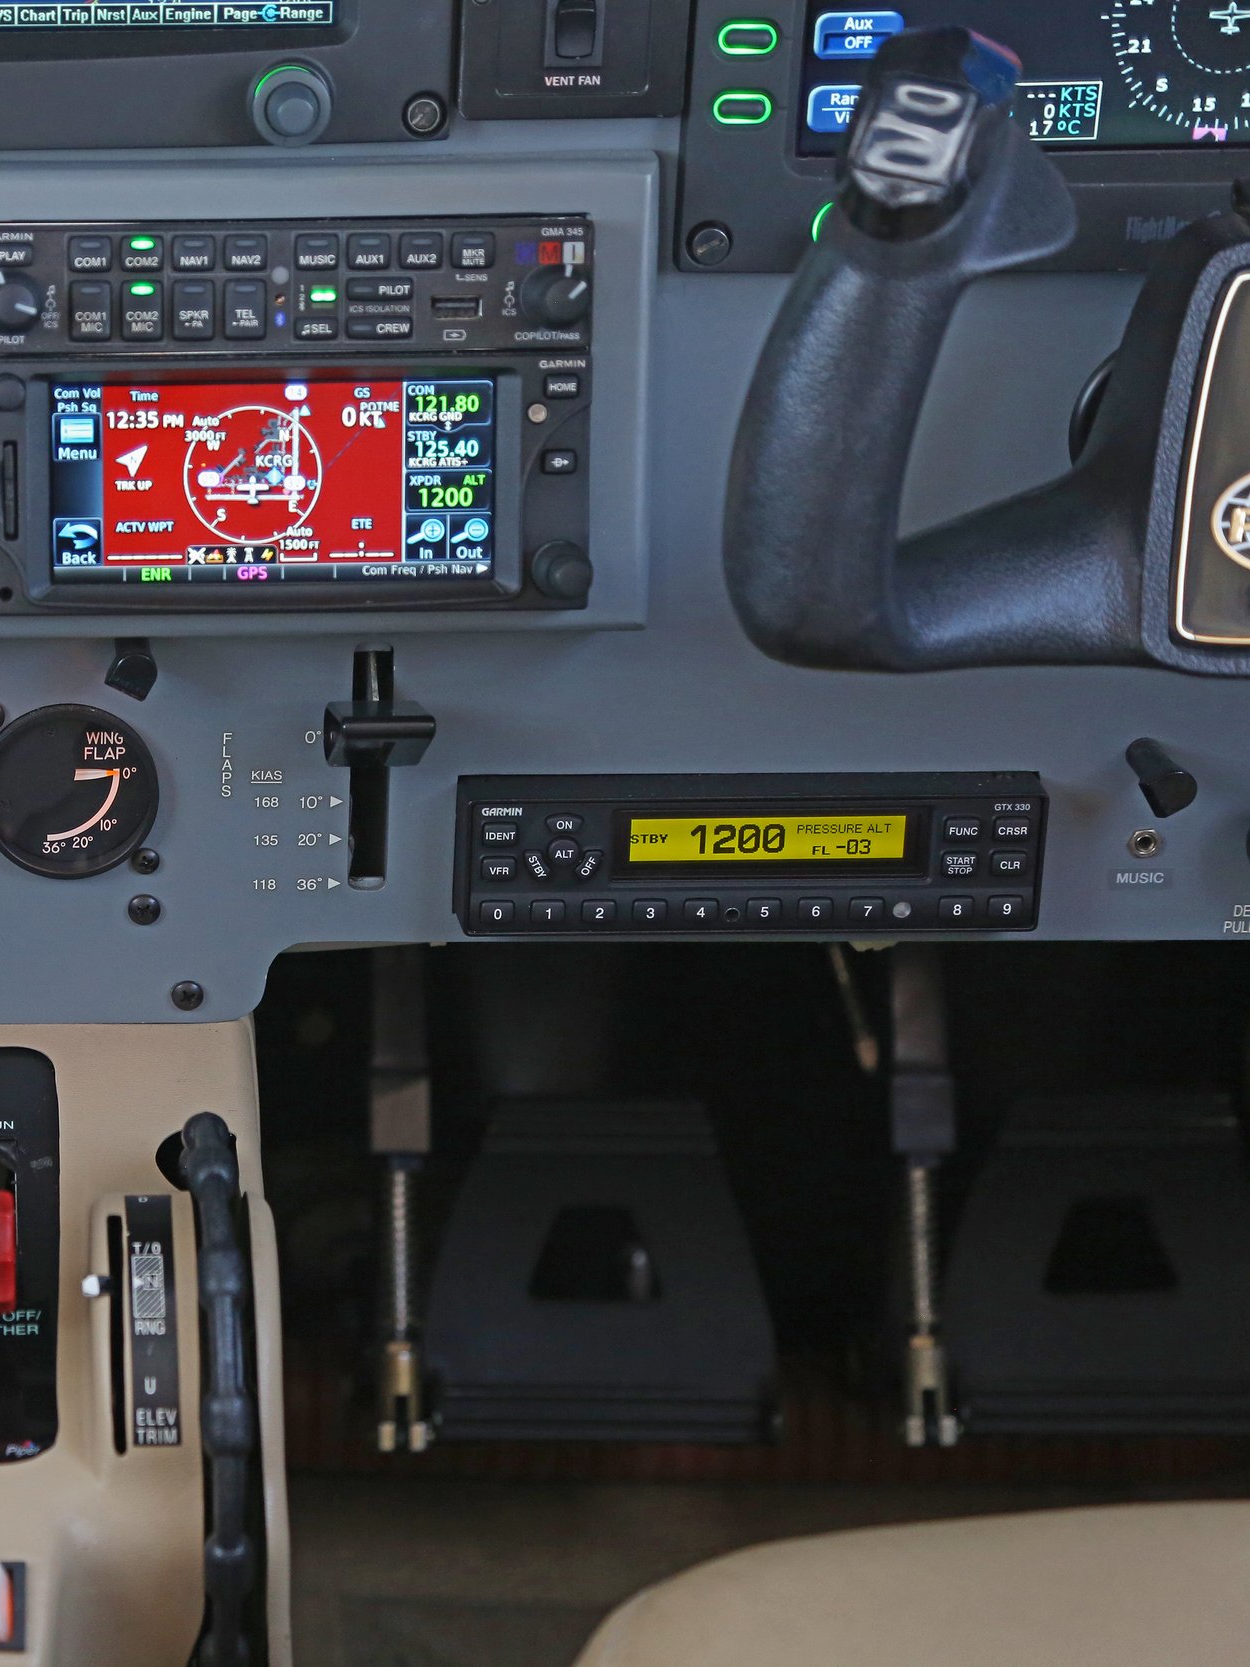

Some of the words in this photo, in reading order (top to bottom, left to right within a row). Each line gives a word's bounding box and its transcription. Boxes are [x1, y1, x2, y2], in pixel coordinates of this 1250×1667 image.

[20, 10, 56, 22] Chart
[63, 9, 89, 23] Trip
[97, 9, 125, 21] Nrst
[132, 9, 158, 20] Aux
[165, 8, 212, 21] Engine
[224, 8, 258, 22] Page
[280, 7, 323, 21] Range
[844, 17, 873, 31] Aux
[844, 36, 872, 49] OFF
[1128, 39, 1151, 53] 21
[545, 76, 575, 87] VENT
[578, 75, 601, 86] FAN
[1061, 86, 1097, 101] KTS
[1192, 97, 1216, 112] 15
[1044, 104, 1055, 119] 0
[1059, 104, 1096, 118] KTS
[541, 228, 564, 237] GMA
[566, 227, 584, 236] 345
[74, 257, 107, 268] COM1
[125, 256, 158, 267] COM2
[180, 256, 208, 266] NAV1
[231, 255, 261, 265] NAV2
[378, 285, 411, 295] PILOT
[179, 310, 209, 320] SPKR
[234, 309, 256, 319] TEL
[538, 360, 586, 369] GARMIN
[54, 388, 79, 399] Com
[83, 388, 100, 399] Vol
[407, 385, 435, 396] COM
[415, 395, 480, 413] 121.80
[106, 411, 159, 429] 12:35
[163, 414, 184, 428] PM
[58, 448, 97, 460] Menu
[415, 440, 479, 458] 125.40
[409, 476, 441, 486] XPDR
[463, 475, 486, 486] ALT
[418, 487, 473, 508] 1200
[62, 551, 96, 565] Back
[456, 546, 483, 559] Out
[141, 568, 171, 581] ENR
[237, 566, 268, 580] GPS
[86, 731, 123, 745] WING
[84, 746, 126, 761] FLAP
[221, 732, 233, 797] FLAPS
[251, 770, 283, 781] KIAS
[481, 807, 523, 817] GARMIN
[556, 820, 573, 830] ON
[797, 824, 862, 835] PRESSURE
[867, 823, 892, 834] ALT
[485, 831, 515, 841] IDENT
[949, 827, 978, 836] FUNC
[998, 827, 1028, 836] CRSR
[630, 834, 668, 844] STBY
[690, 823, 786, 855] 1200
[555, 849, 574, 859] ALT
[812, 845, 830, 856] FL
[947, 857, 975, 865] START
[1000, 861, 1020, 870] CLR
[489, 866, 509, 875] VFR
[948, 867, 972, 875] STOP
[1116, 872, 1164, 884] MUSIC
[132, 1242, 162, 1255] T/O
[134, 1320, 166, 1336] RNG
[136, 1408, 177, 1426] ELEV
[136, 1428, 178, 1444] TRIM
